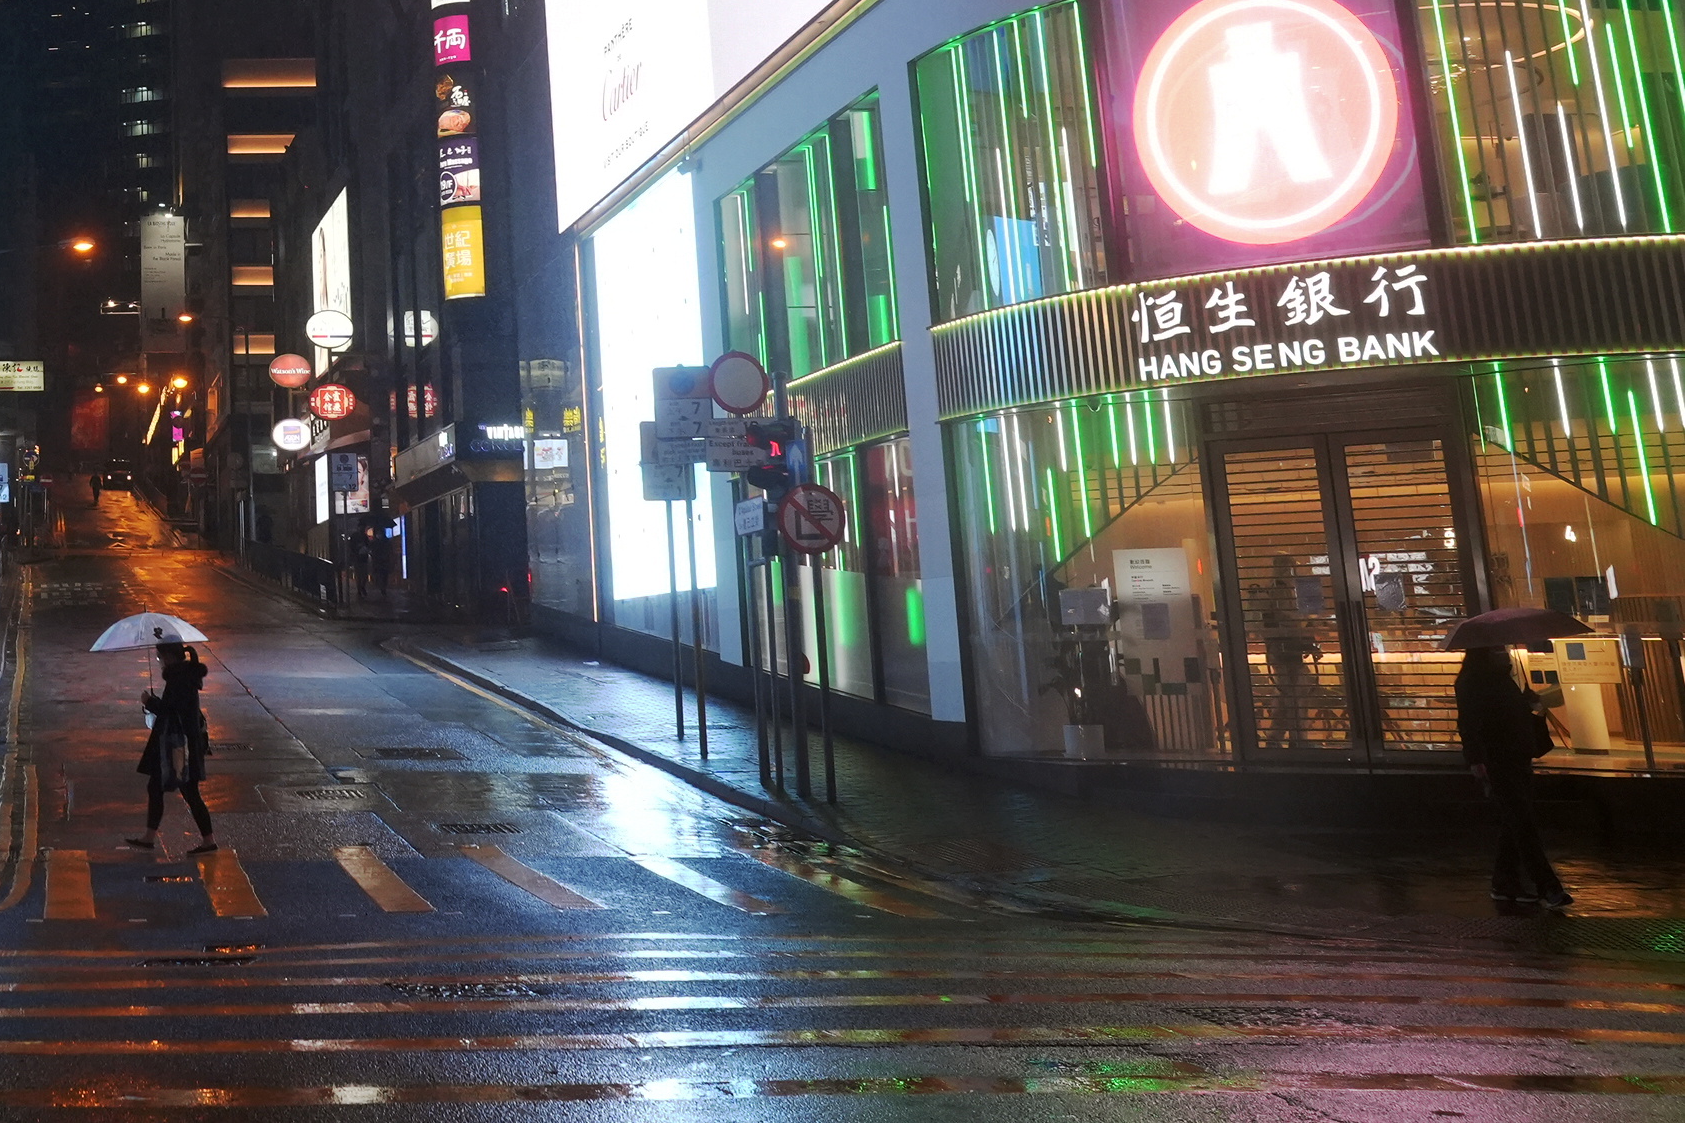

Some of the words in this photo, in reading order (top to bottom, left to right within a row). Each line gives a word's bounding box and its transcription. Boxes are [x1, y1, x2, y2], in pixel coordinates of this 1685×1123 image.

[602, 61, 643, 122] Cartier
[444, 230, 472, 250] 世紀
[1131, 264, 1428, 344] 恒生銀行
[1138, 349, 1222, 381] HANG
[1232, 340, 1326, 372] SENG
[1337, 330, 1440, 363] BANK
[691, 402, 701, 415] 7
[693, 421, 702, 434] 7
[709, 440, 736, 449] Except
[731, 448, 755, 456] buses
